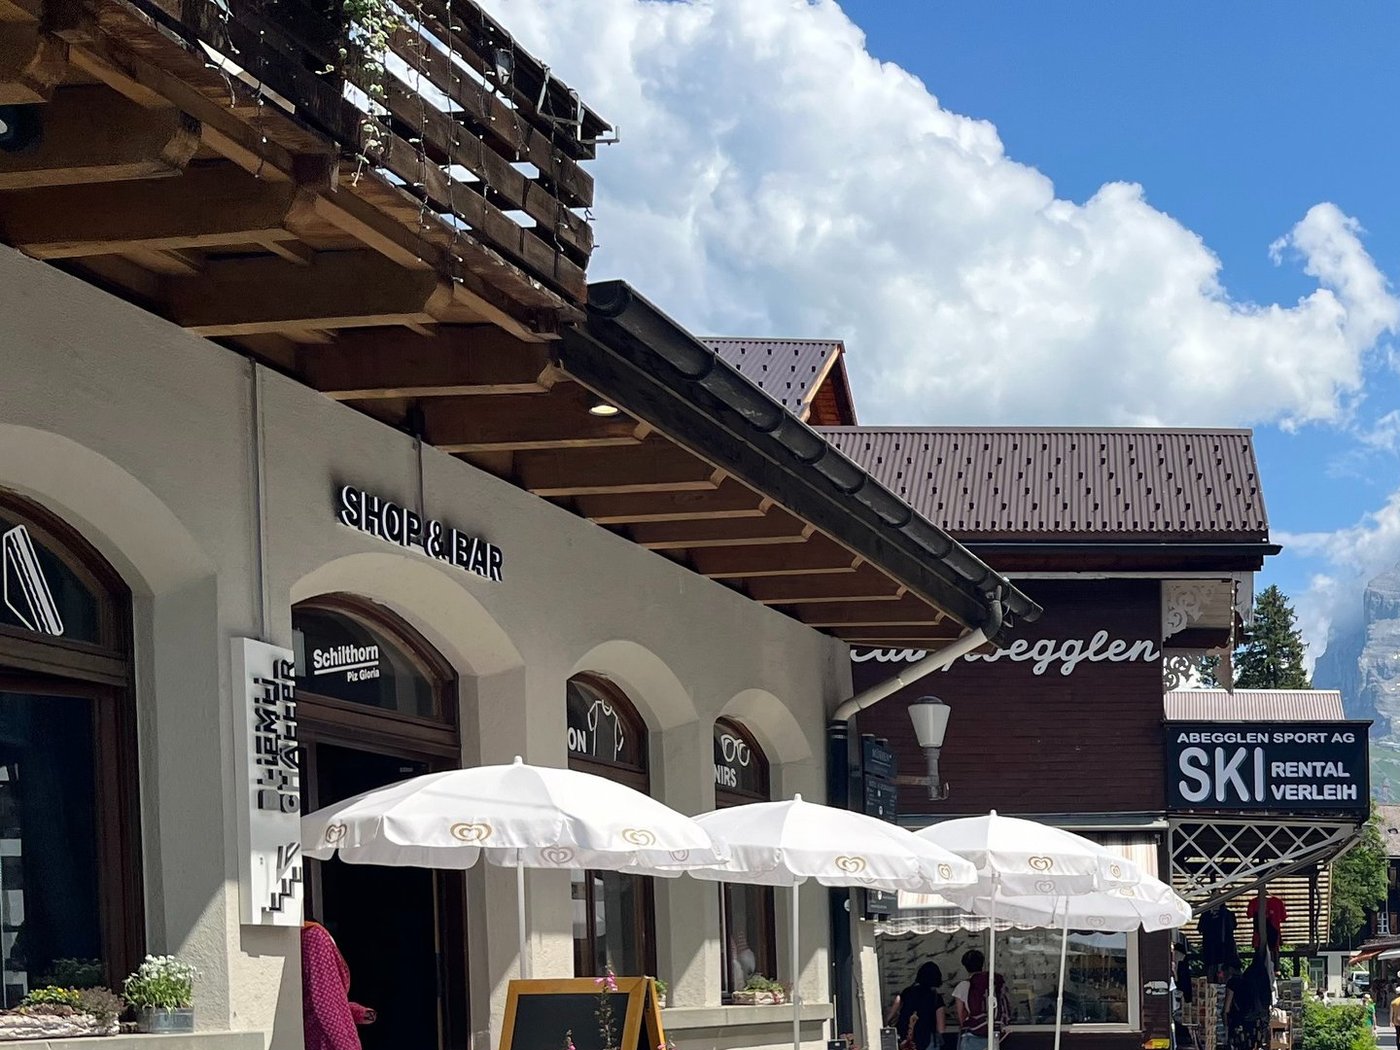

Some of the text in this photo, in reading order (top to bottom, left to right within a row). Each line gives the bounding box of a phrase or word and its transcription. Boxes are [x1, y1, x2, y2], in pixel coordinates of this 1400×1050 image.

[340, 485, 503, 582] SHOP & BAR
[313, 644, 379, 669] Schilthorn
[347, 667, 380, 682] Piz Gloria
[1177, 732, 1355, 744] ABEGGLEN SPORT AG
[1178, 746, 1266, 803] SKI
[1271, 761, 1350, 778] RENTAL
[1270, 784, 1358, 801] VERLEIH
